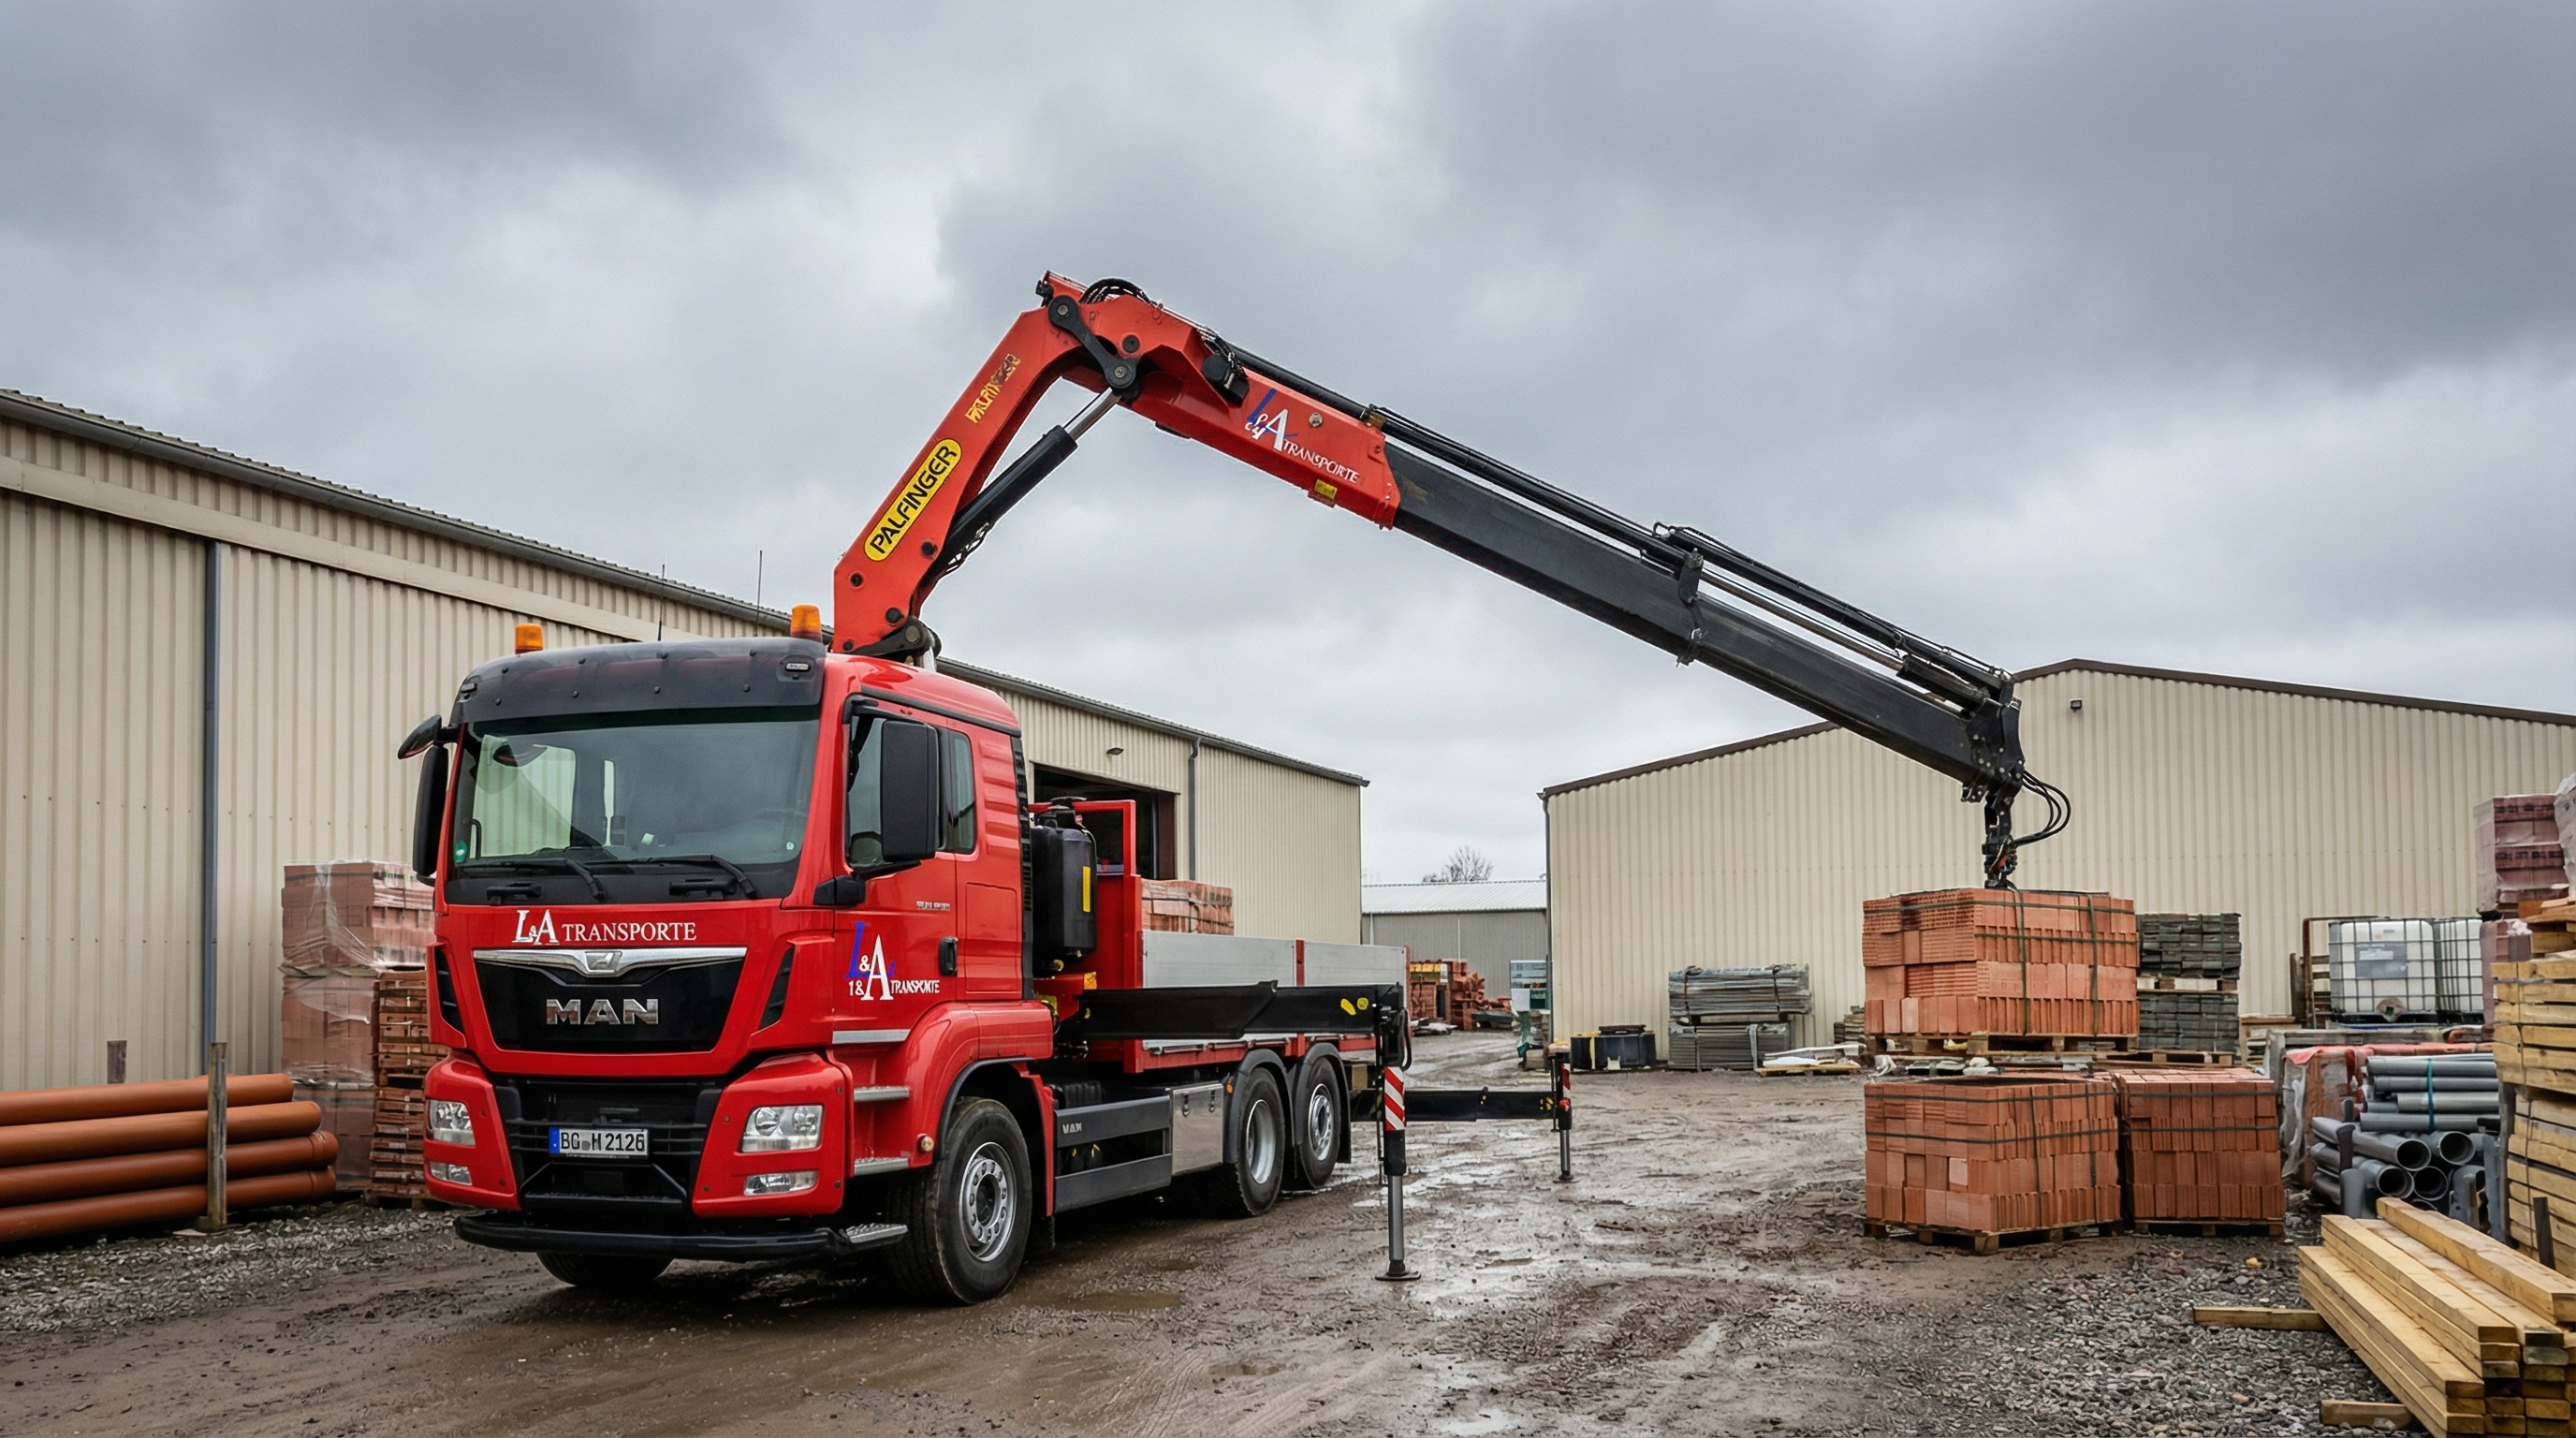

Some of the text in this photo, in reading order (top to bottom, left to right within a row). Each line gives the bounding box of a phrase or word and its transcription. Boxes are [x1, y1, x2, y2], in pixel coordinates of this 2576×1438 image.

[869, 445, 958, 554] PALFINGER
[511, 909, 697, 946] L&A TRANSPORTE
[546, 998, 659, 1025] MAN
[561, 1132, 580, 1151] BG
[605, 1133, 646, 1152] 2126
